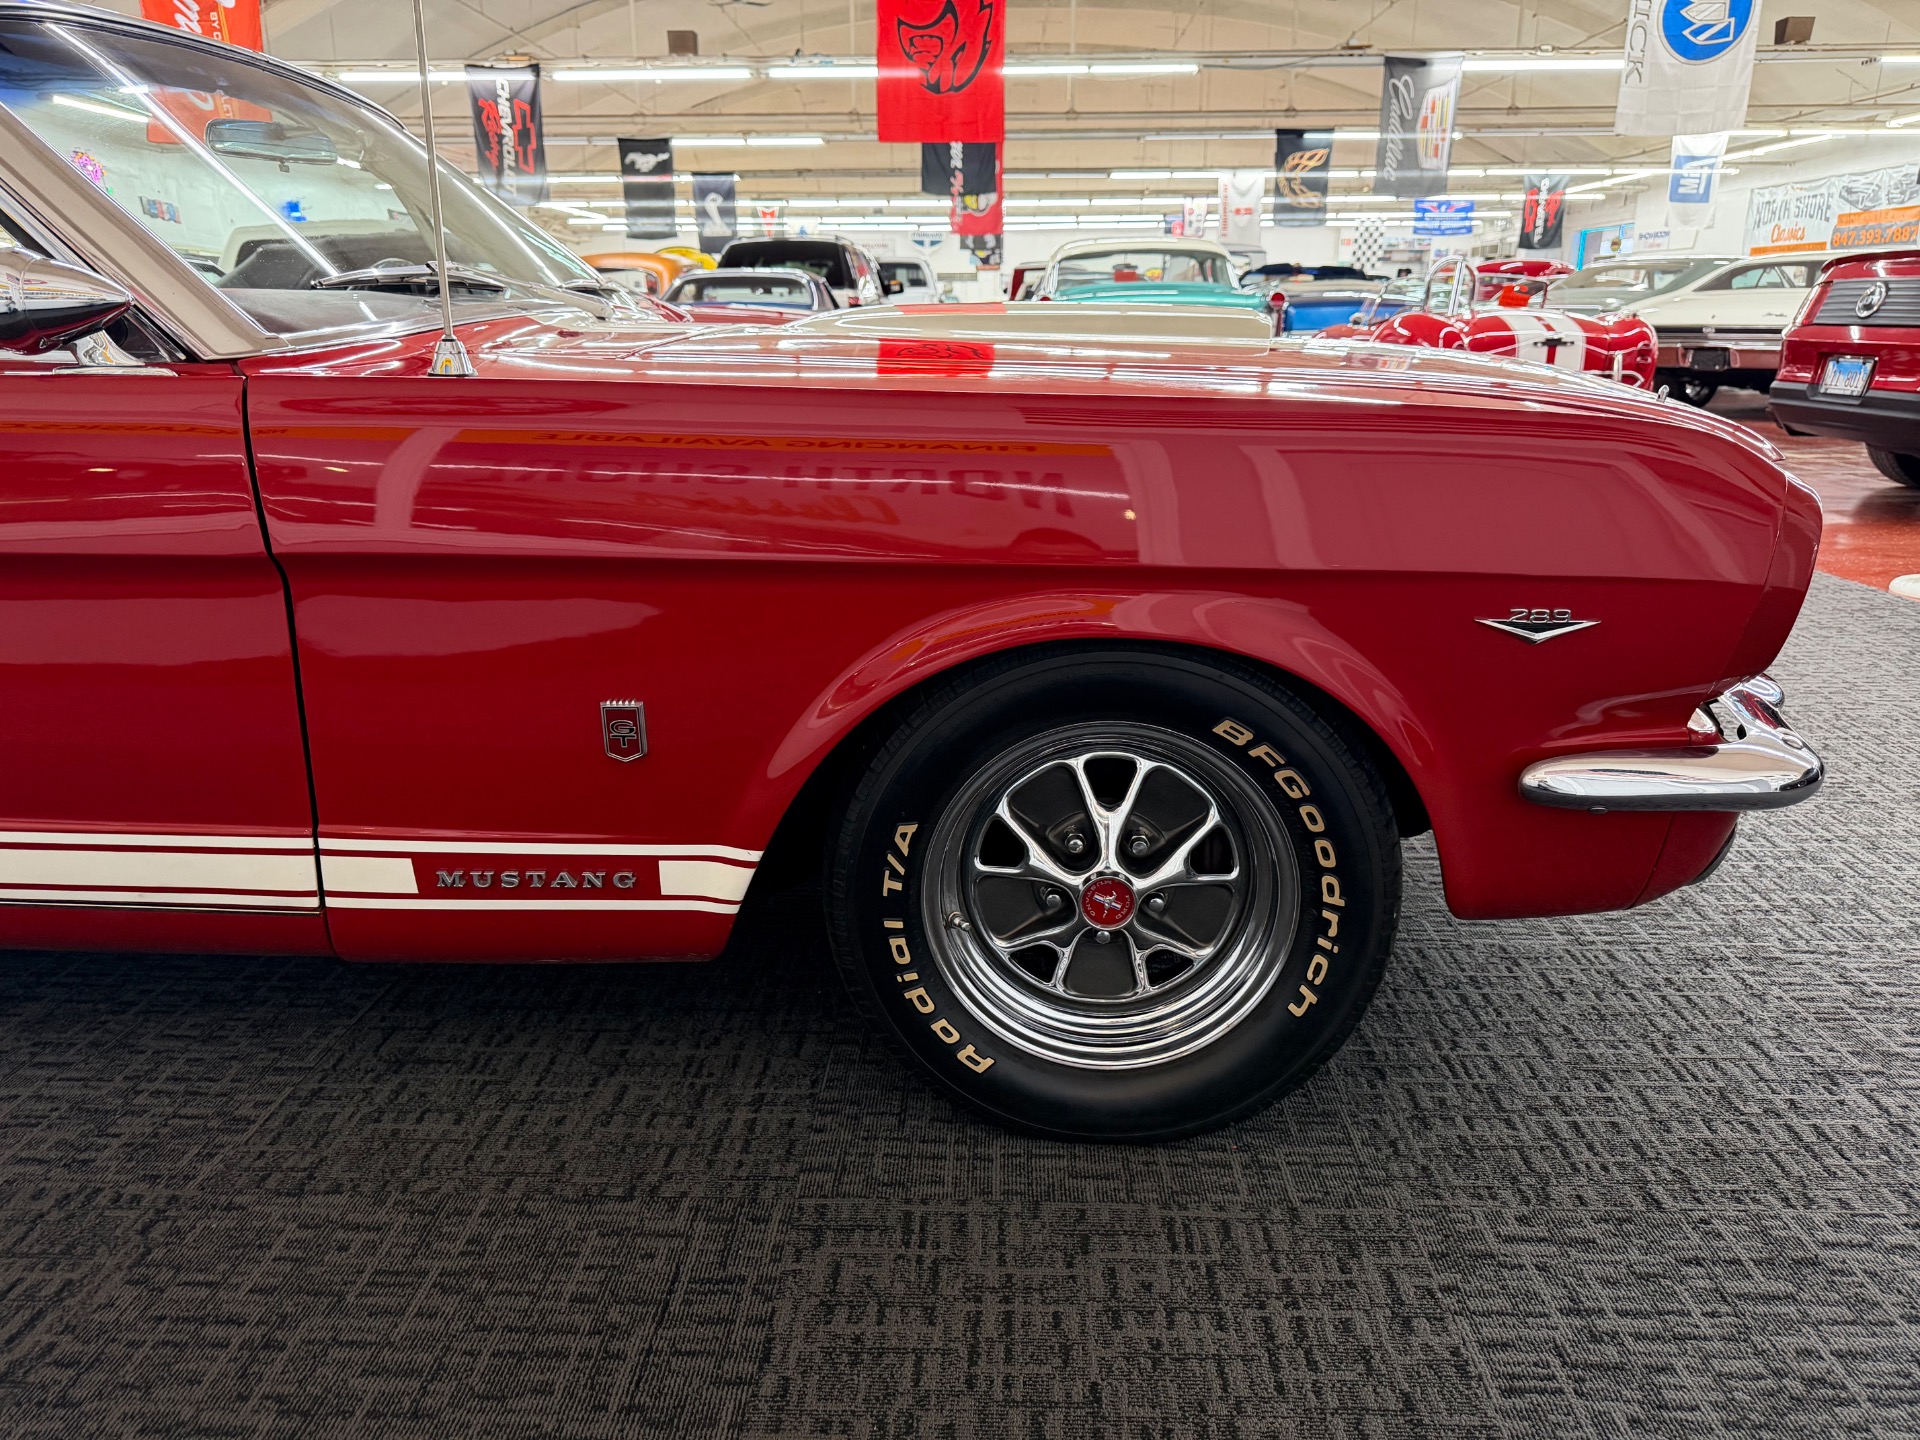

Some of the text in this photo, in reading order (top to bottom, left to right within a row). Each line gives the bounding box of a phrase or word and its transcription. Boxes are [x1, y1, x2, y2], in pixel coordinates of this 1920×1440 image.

[210, 12, 220, 29] BY
[496, 77, 517, 197] CHEVROLET
[1384, 75, 1414, 181] Cadillac
[1794, 193, 1834, 222] SHORE
[1771, 224, 1806, 243] Classics
[1832, 226, 1918, 247] 847.393.7887
[1508, 608, 1571, 624] 289
[609, 719, 638, 748] GT
[435, 869, 637, 889] MUSTANG
[1211, 718, 1346, 1018] BFGoodrich
[882, 822, 996, 1074] Radial T/A
